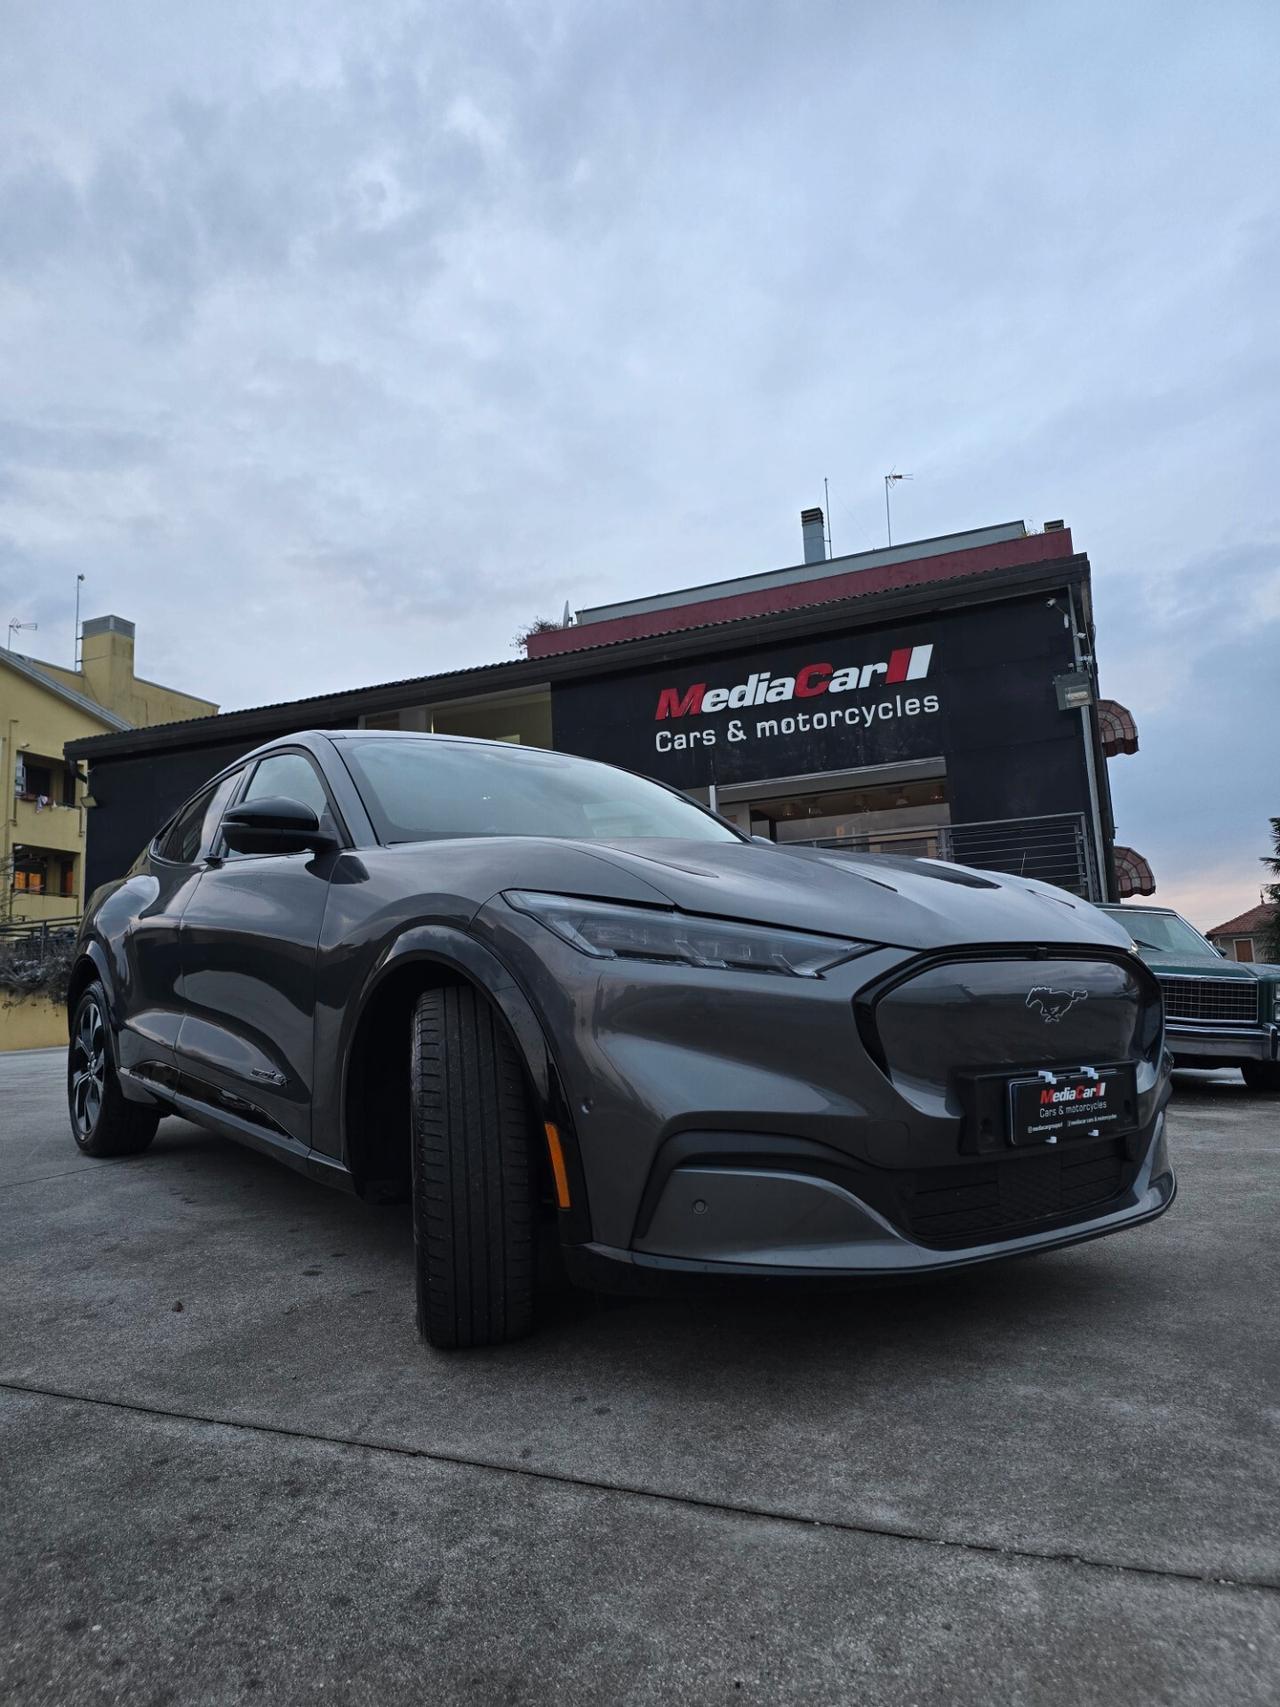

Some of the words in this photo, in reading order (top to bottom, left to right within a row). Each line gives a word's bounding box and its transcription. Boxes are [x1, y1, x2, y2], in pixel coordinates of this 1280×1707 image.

[655, 662, 888, 720] MediaCar
[655, 730, 716, 752] Cars
[727, 720, 747, 742] &
[756, 694, 940, 738] motorcycles
[1039, 1107, 1057, 1118] Cars
[1058, 1105, 1064, 1115] &
[1065, 1100, 1107, 1114] motorcycles
[1040, 1085, 1096, 1104] MediaCar
